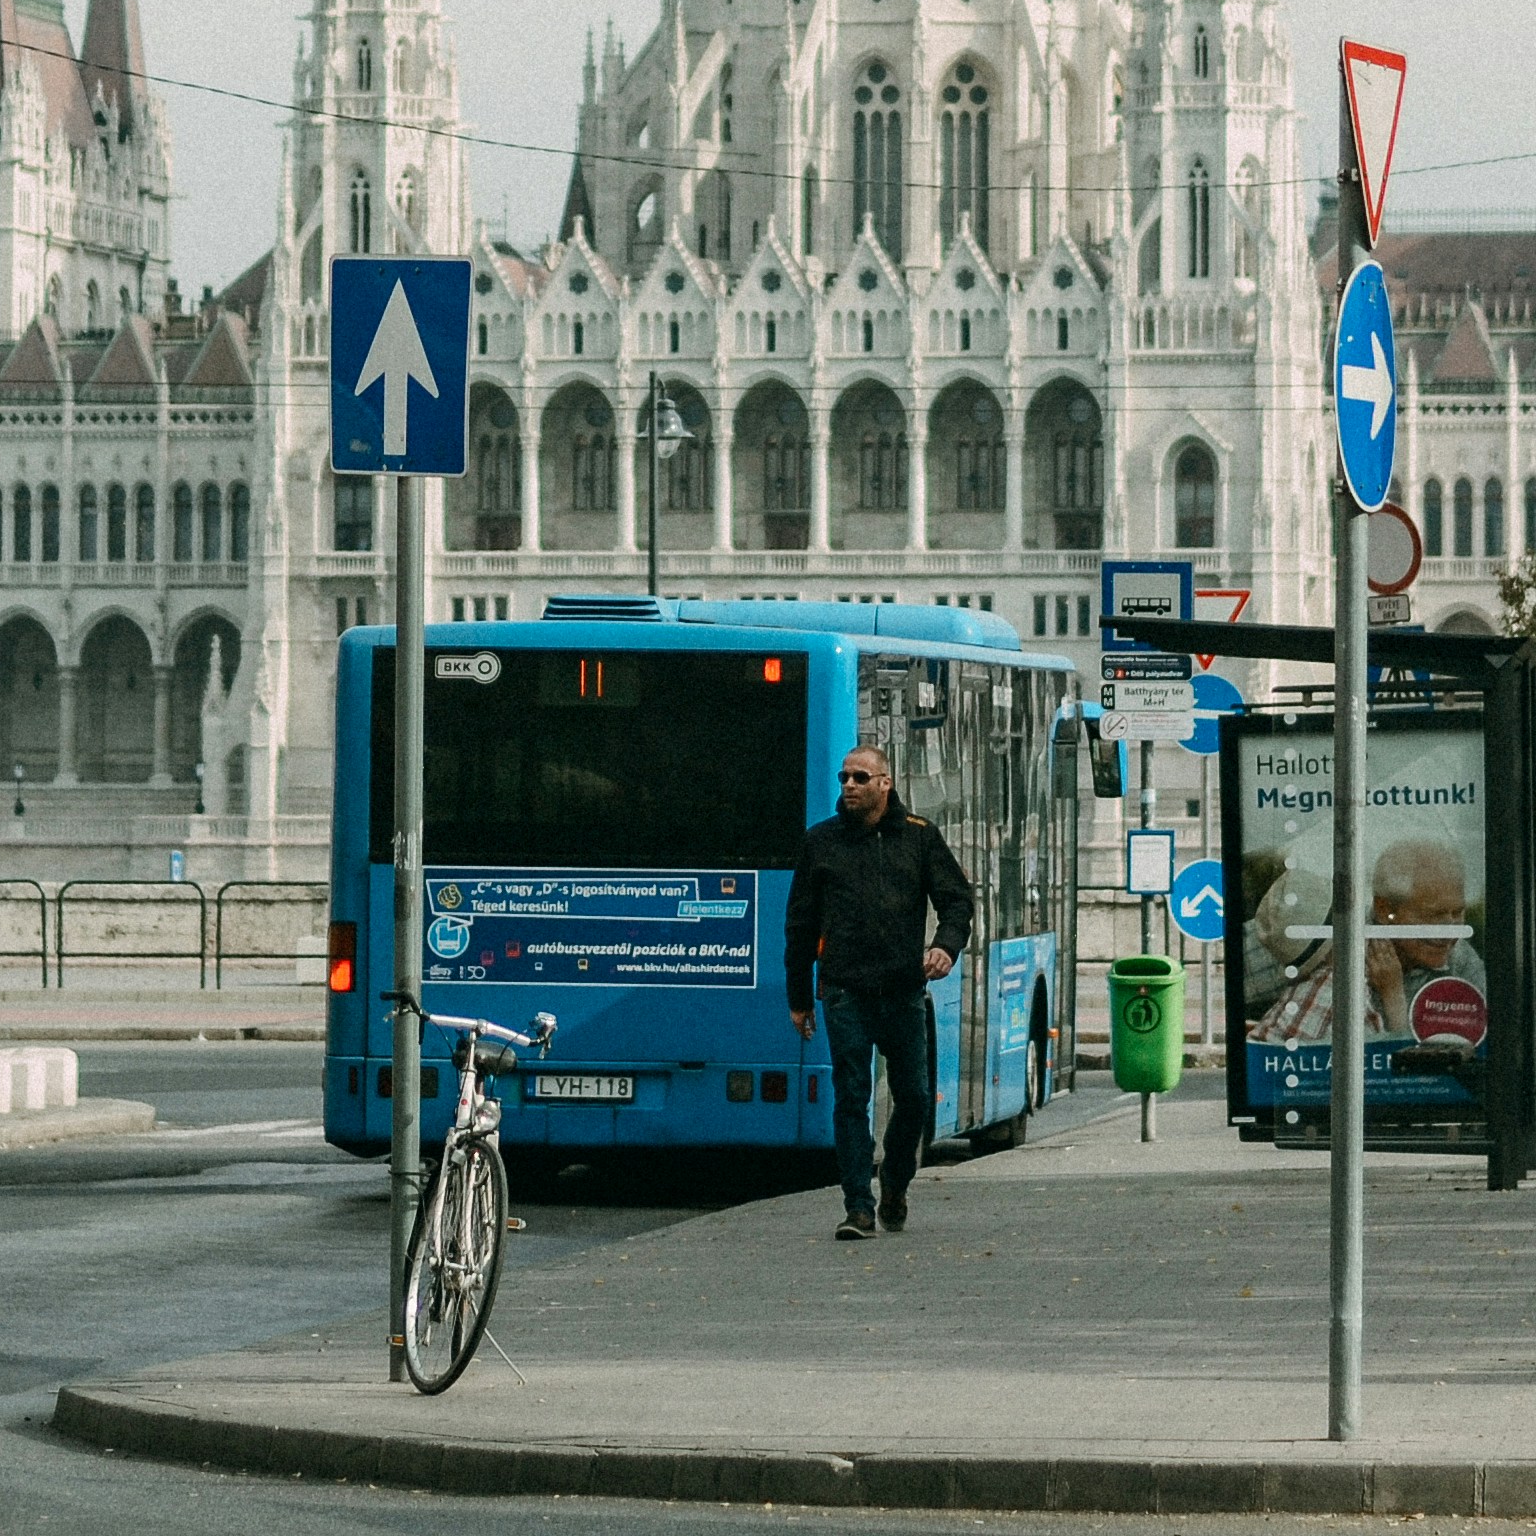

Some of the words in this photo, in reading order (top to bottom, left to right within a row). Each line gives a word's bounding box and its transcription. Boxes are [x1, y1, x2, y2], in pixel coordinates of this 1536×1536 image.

[444, 662, 471, 672] BKK
[505, 884, 533, 897] vagy
[571, 883, 656, 898] jogosítványod
[660, 884, 689, 897] van?
[471, 899, 506, 913] Téged
[509, 899, 569, 913] keresünk!
[527, 942, 631, 956] autóbuszvezetői
[633, 942, 686, 958] pozíciók
[688, 946, 697, 956] a
[699, 943, 751, 957] BKV-nál
[1425, 999, 1478, 1013] Ingyenes
[539, 1077, 629, 1096] LYH-118
